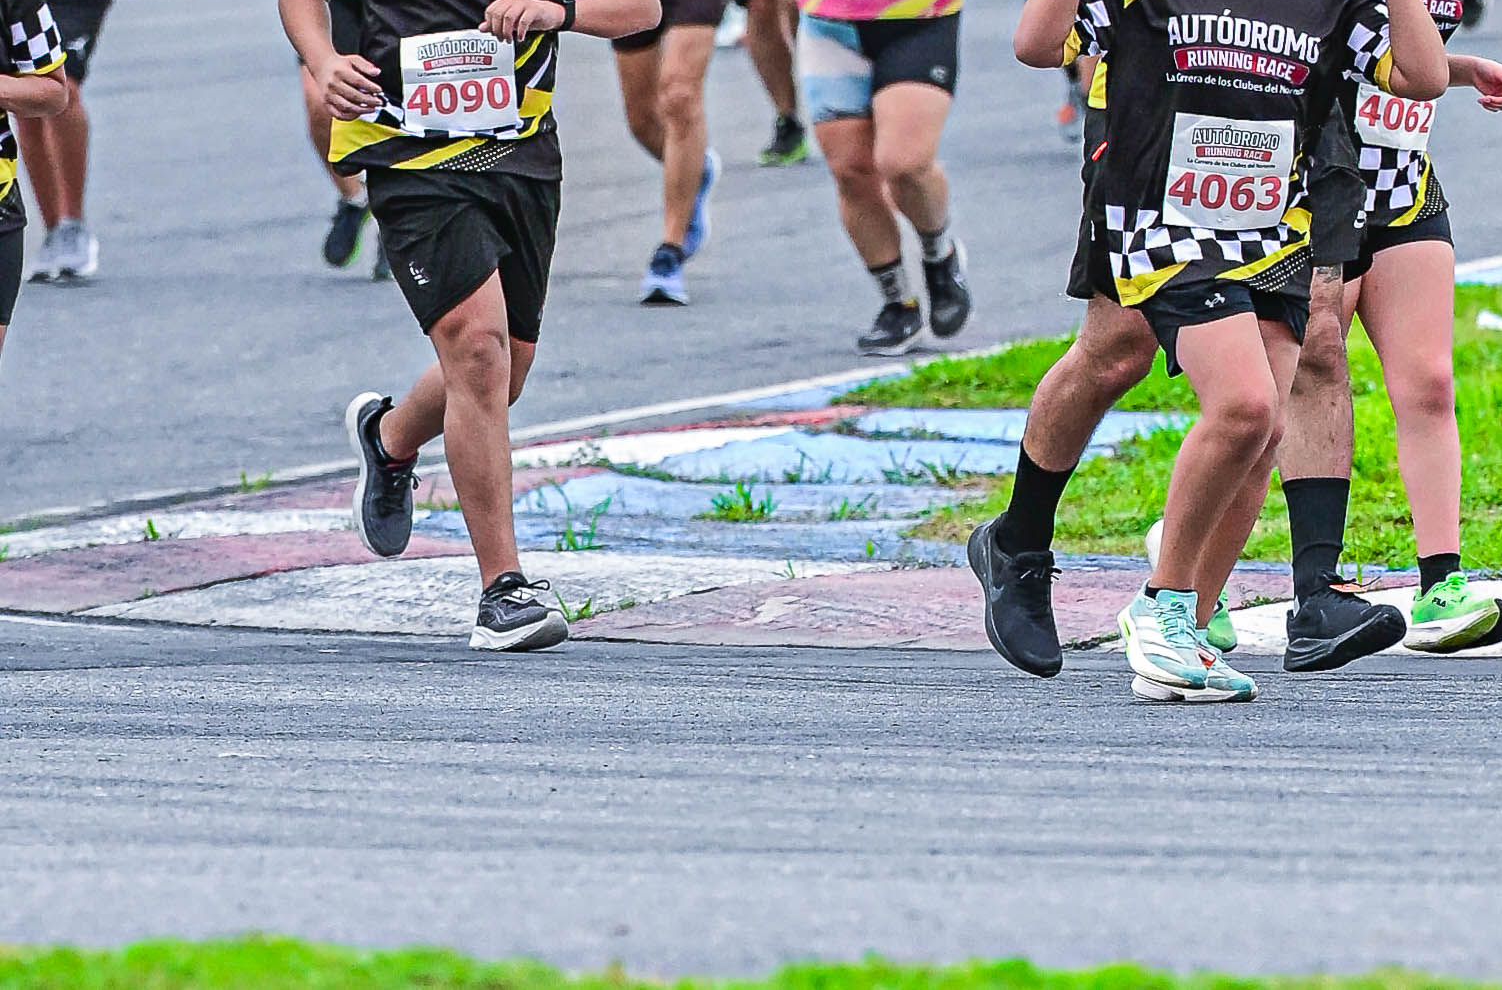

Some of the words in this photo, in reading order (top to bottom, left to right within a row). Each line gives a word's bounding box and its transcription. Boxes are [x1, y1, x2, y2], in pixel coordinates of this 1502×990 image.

[1429, 0, 1457, 17] RACE
[417, 36, 498, 61] AUTÓDROMO
[1167, 9, 1322, 64] AUTÓDROMO
[1186, 50, 1253, 71] RUNNING
[1256, 56, 1296, 81] RACE
[407, 77, 511, 116] 4090
[1166, 72, 1176, 82] La
[1204, 74, 1216, 85] de
[1218, 76, 1232, 88] los
[1233, 78, 1263, 91] Clubes
[1264, 83, 1278, 94] del
[1358, 94, 1434, 134] 4062
[1192, 124, 1280, 150] AUTÓDROMO
[1204, 146, 1242, 157] RUNNING
[1243, 150, 1265, 160] RACE
[1168, 171, 1282, 211] 4063
